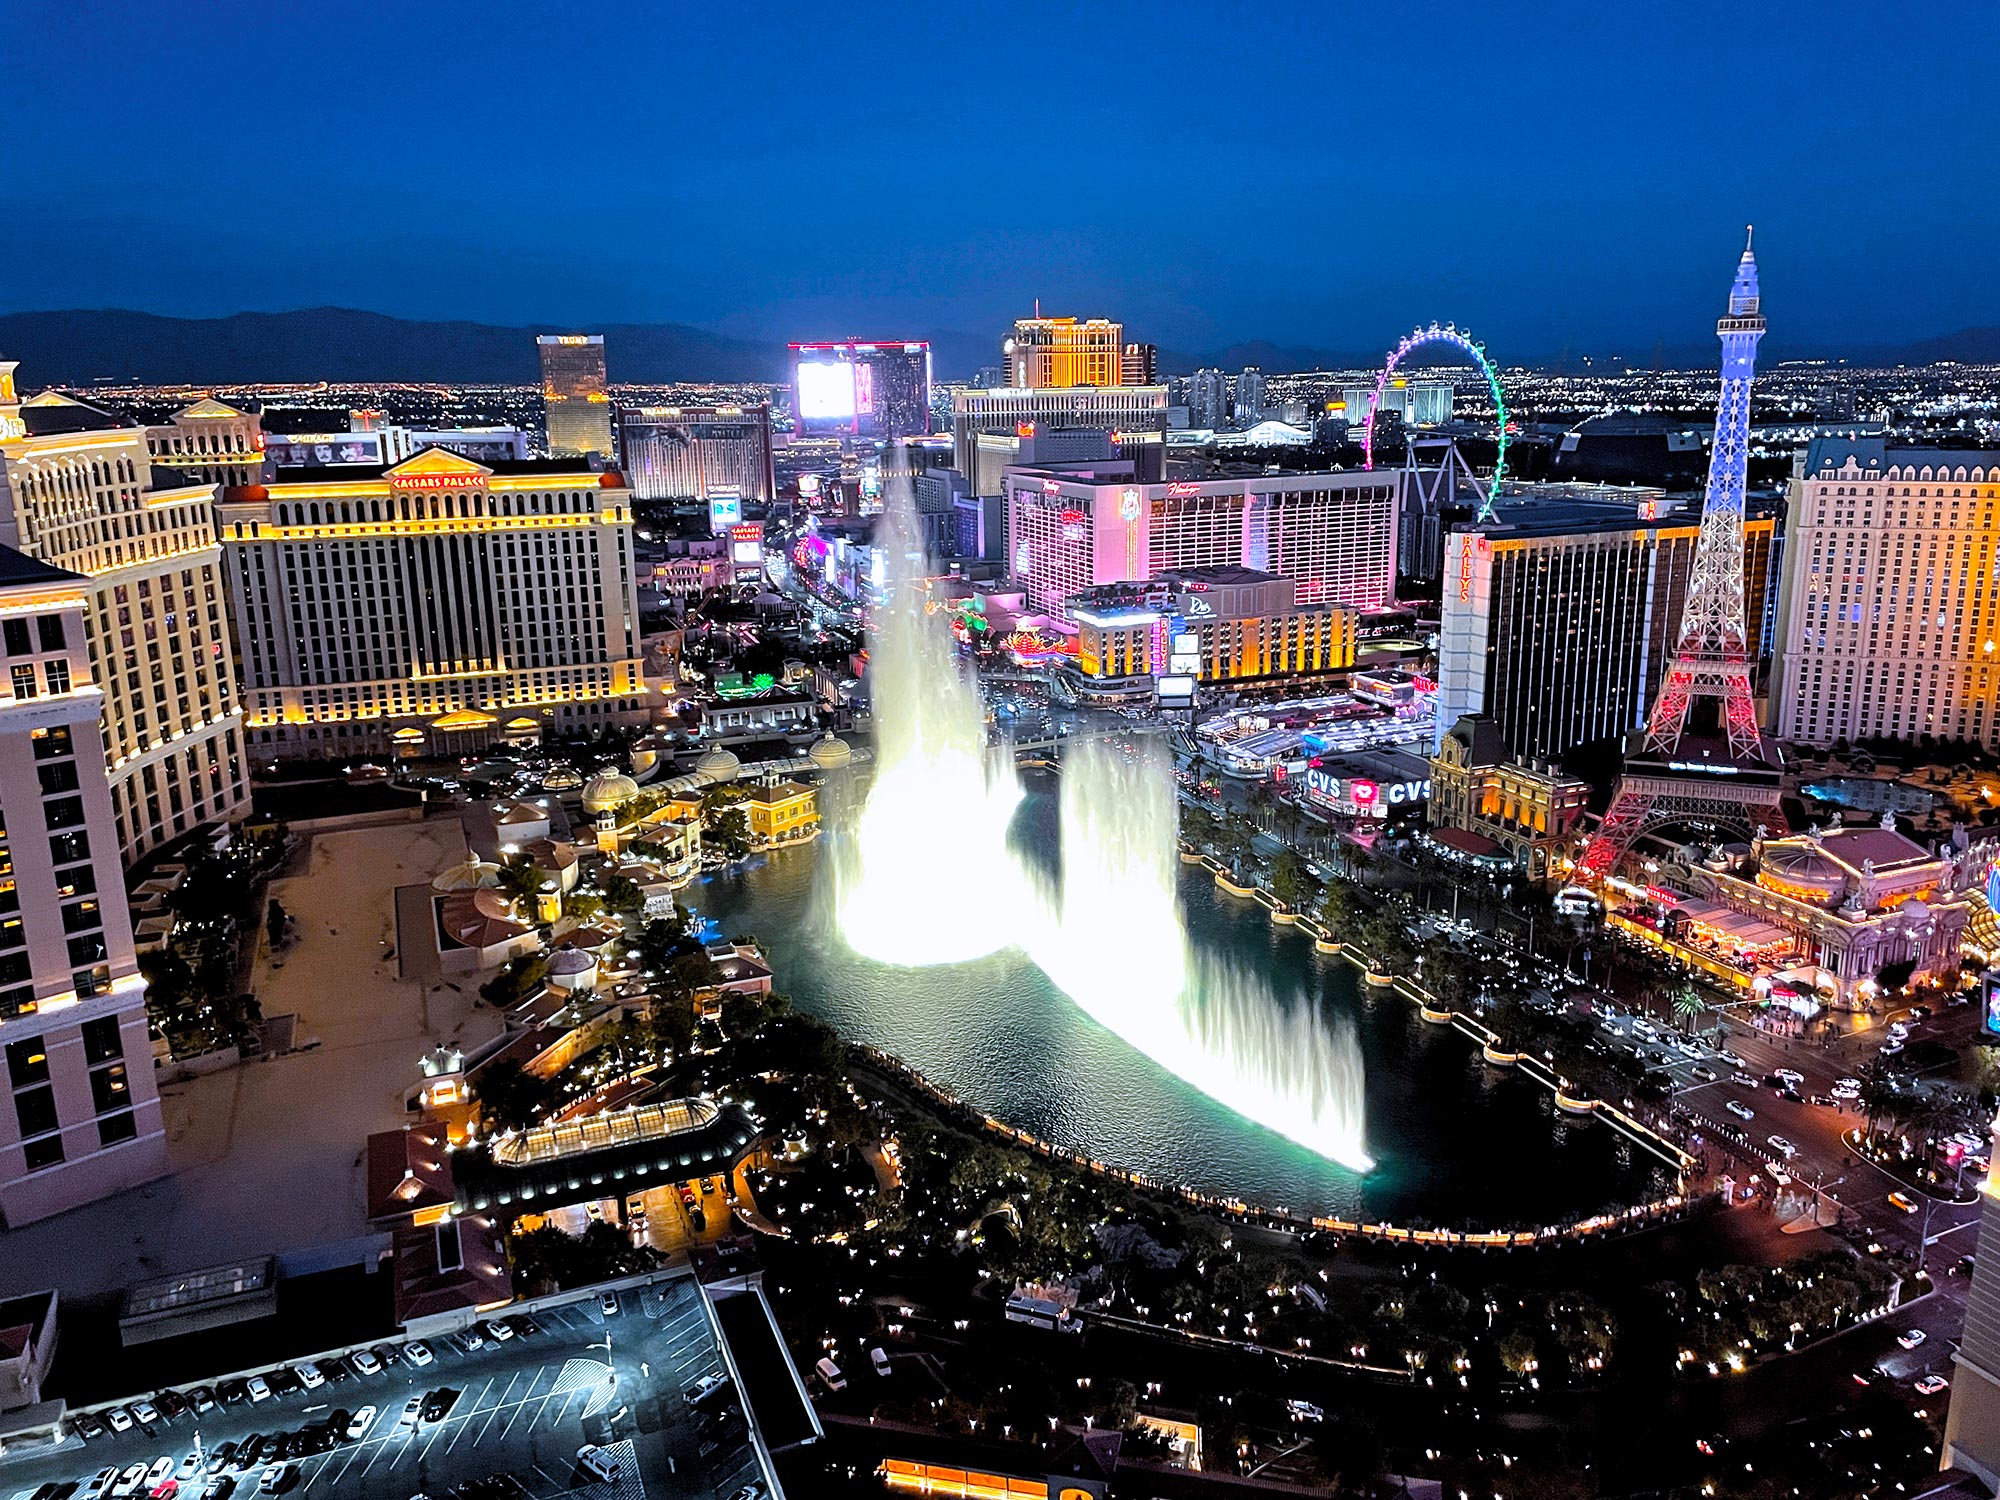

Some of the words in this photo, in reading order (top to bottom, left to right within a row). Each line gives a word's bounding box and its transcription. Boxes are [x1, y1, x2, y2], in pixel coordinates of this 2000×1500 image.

[393, 478, 441, 489] CAESARS
[443, 476, 485, 487] PALACE
[1160, 619, 1169, 669] BALLYS
[1307, 769, 1341, 798] CVS
